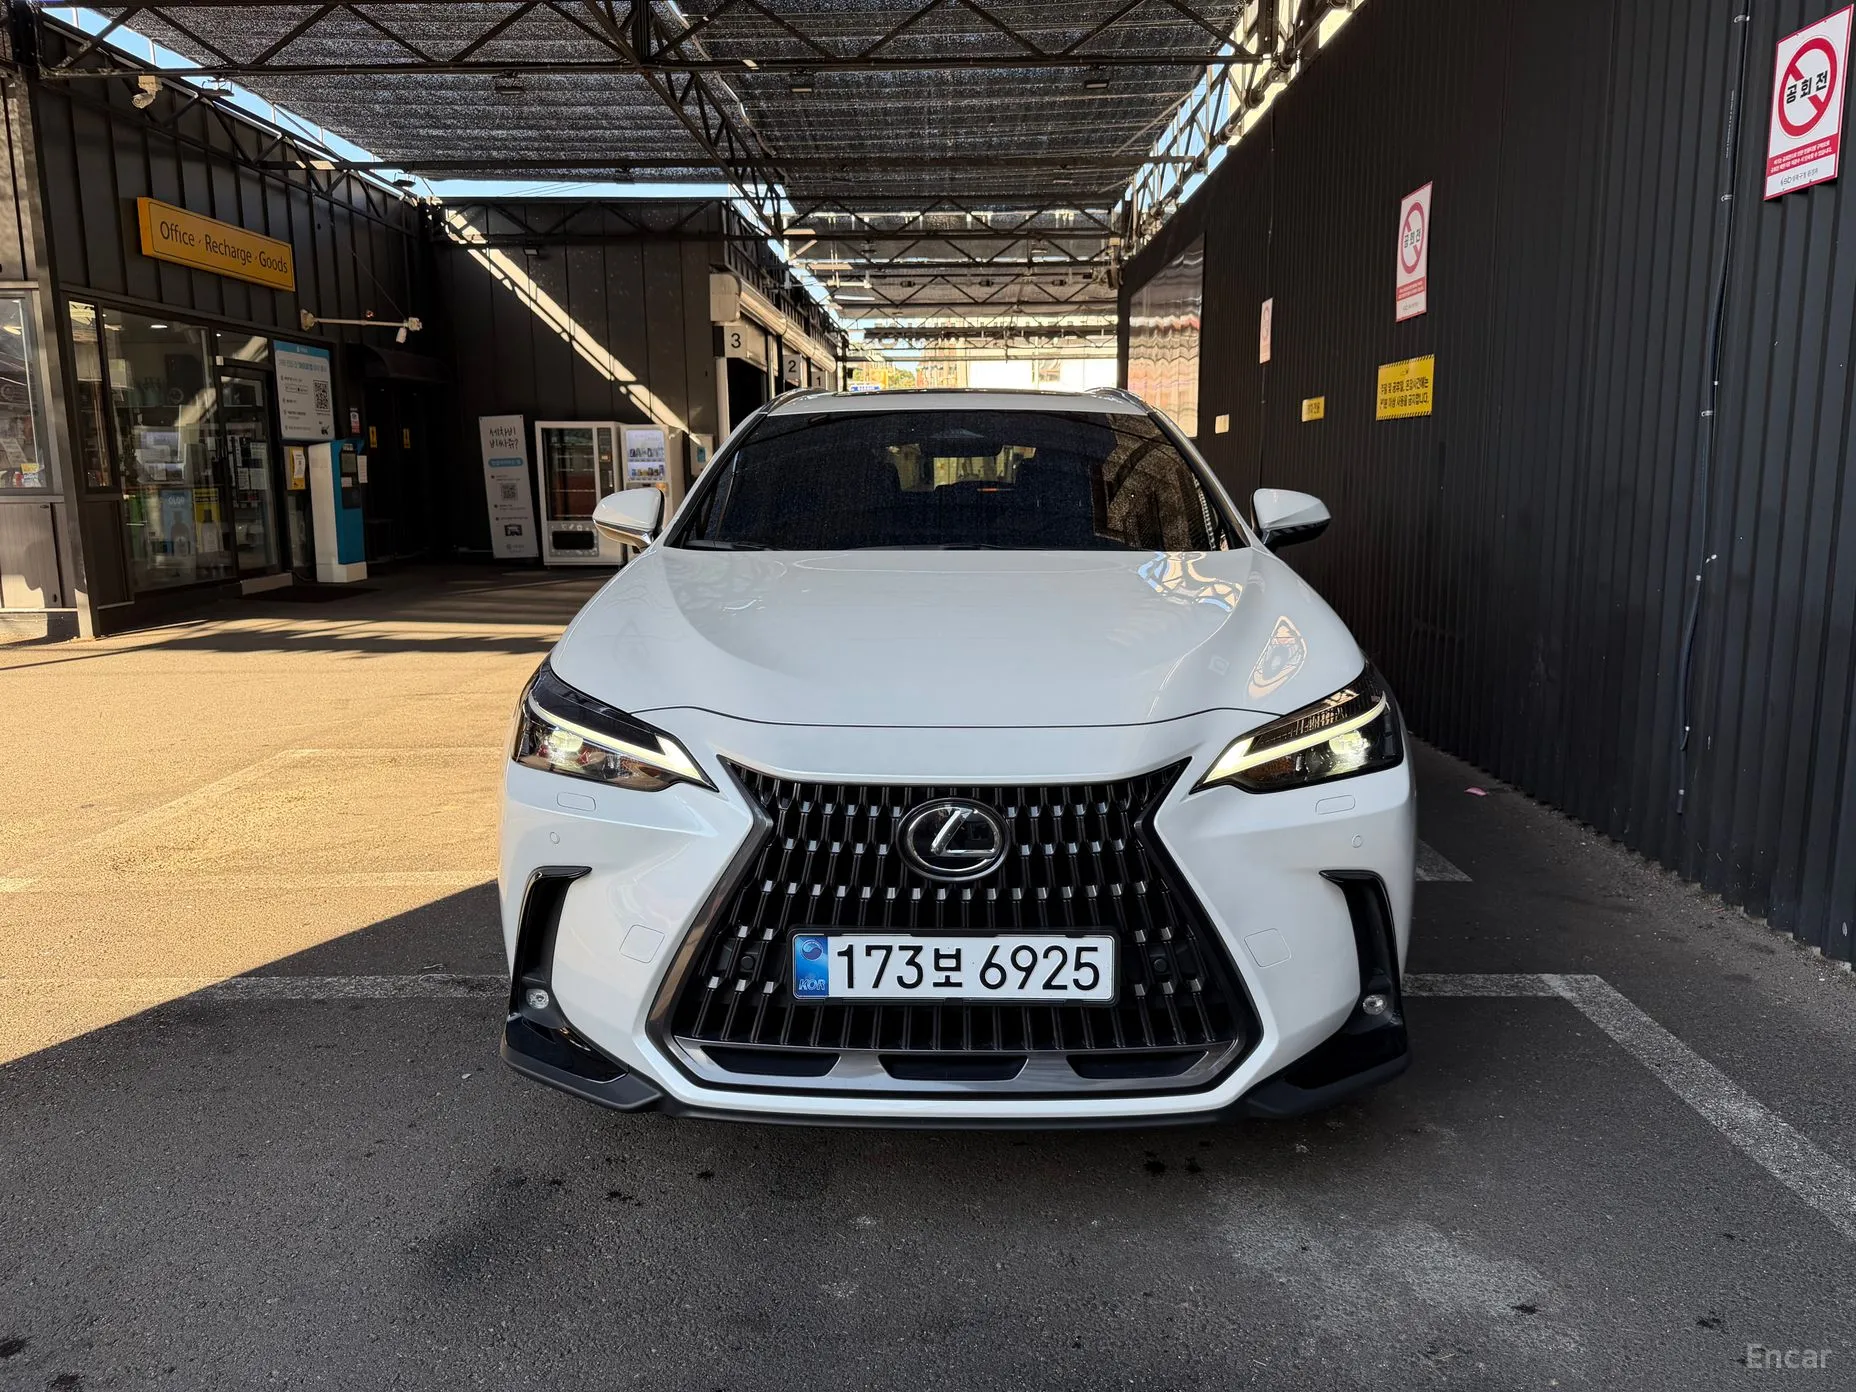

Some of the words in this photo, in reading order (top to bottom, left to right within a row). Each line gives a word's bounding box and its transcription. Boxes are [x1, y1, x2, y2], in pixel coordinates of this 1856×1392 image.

[1785, 70, 1828, 105] 공회전
[159, 221, 195, 247] Office
[205, 234, 252, 266] Recharge
[258, 251, 288, 274] Goods
[730, 332, 742, 349] 3
[788, 360, 797, 373] 2
[816, 376, 821, 387] 1
[837, 944, 963, 990] 173보
[979, 944, 1100, 991] 6925
[798, 978, 826, 991] KOR
